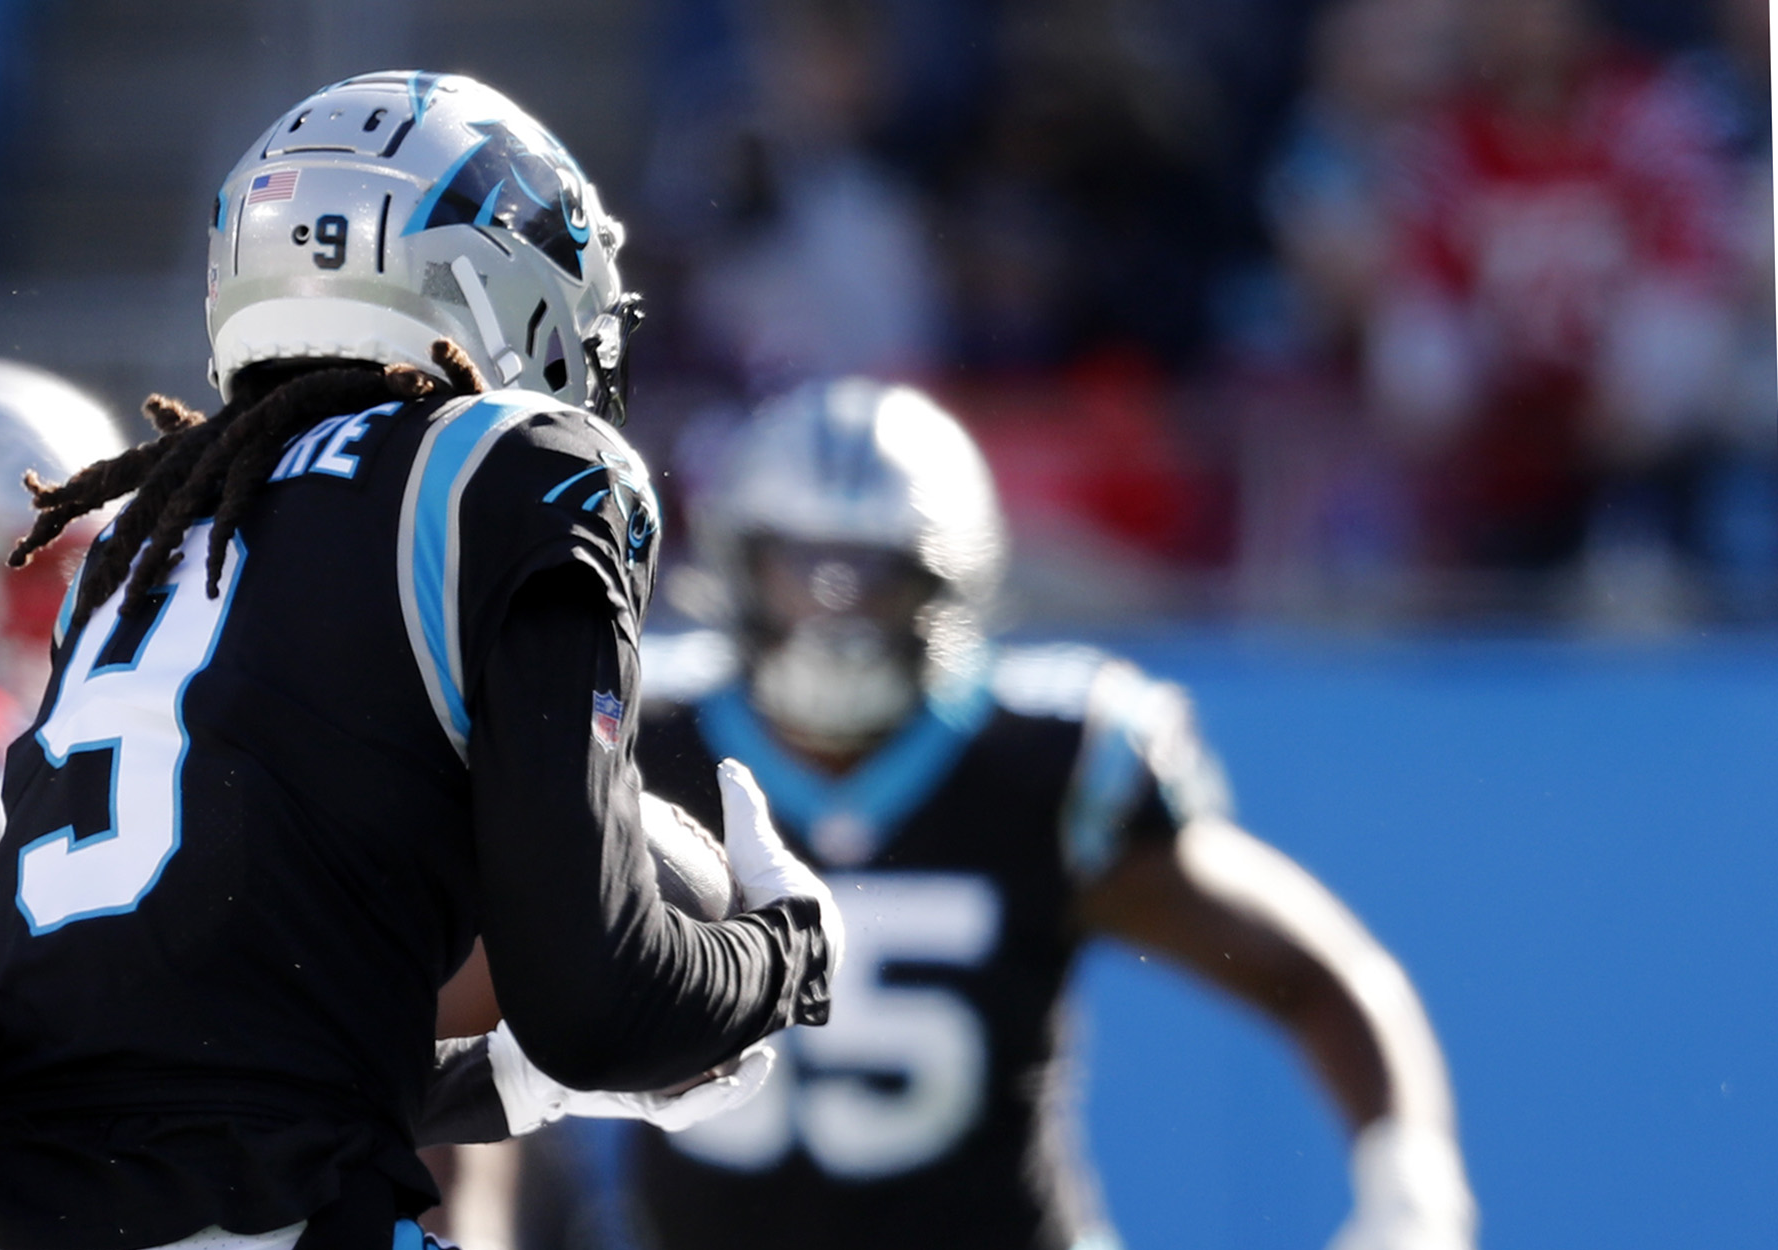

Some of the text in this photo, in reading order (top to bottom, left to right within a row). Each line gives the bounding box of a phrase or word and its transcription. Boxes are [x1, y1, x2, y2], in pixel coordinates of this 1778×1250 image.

[312, 214, 349, 271] 9
[268, 401, 404, 483] RE
[17, 515, 248, 936] 9
